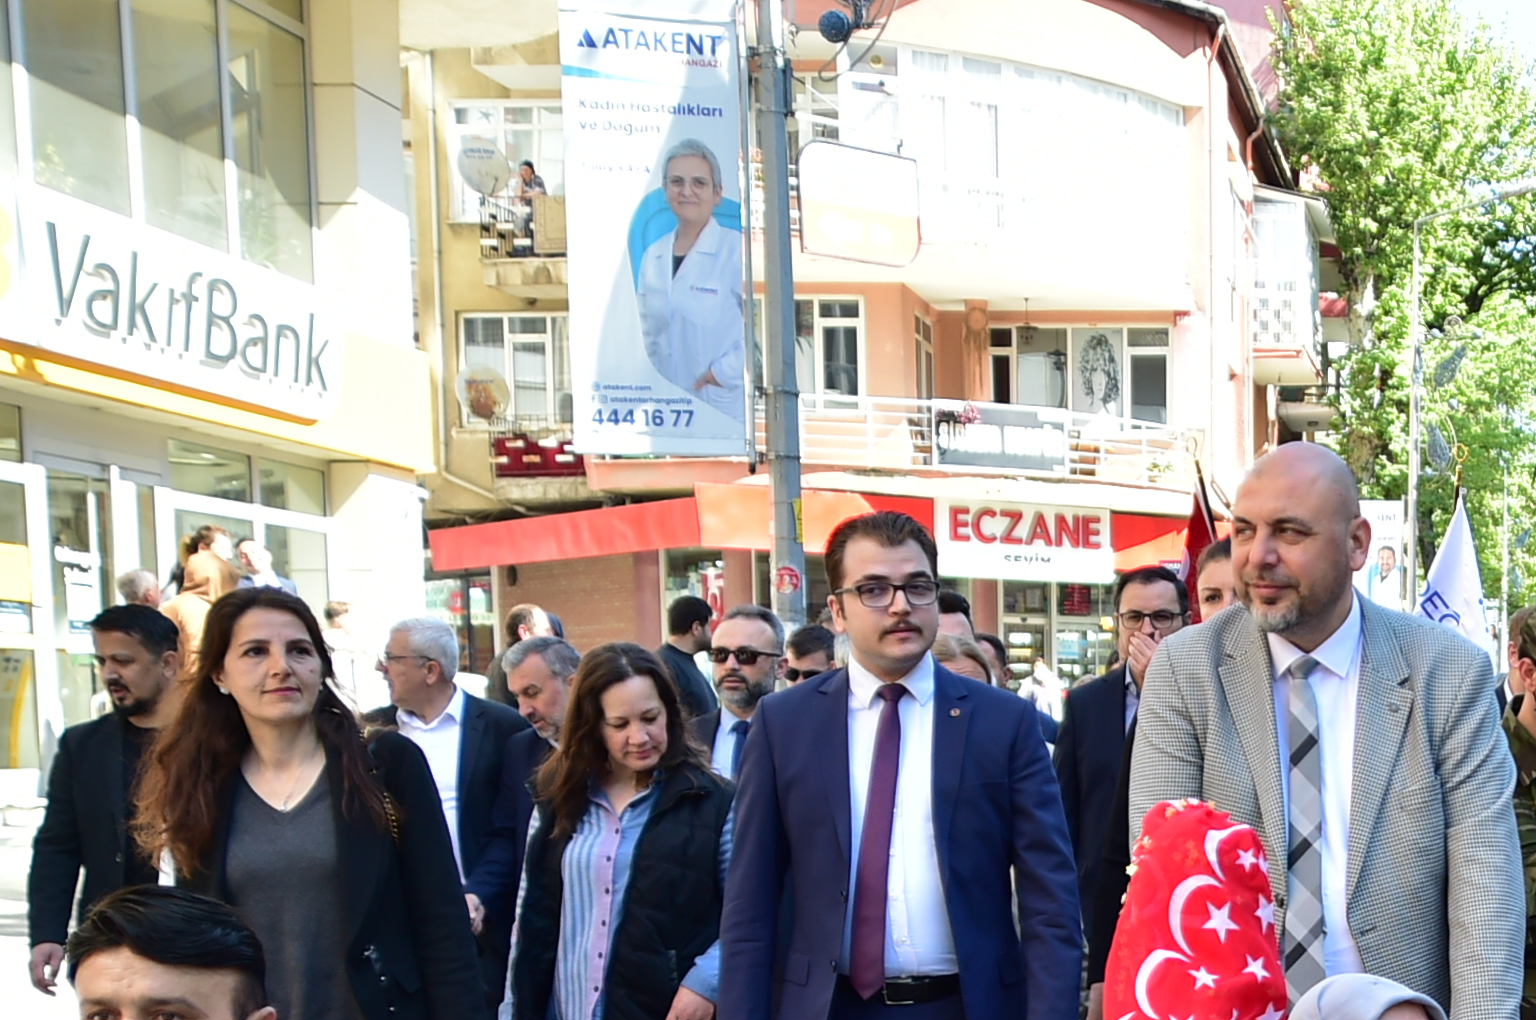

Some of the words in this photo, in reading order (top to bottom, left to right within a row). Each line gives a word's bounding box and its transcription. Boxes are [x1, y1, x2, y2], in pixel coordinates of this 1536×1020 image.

[602, 27, 722, 57] ATAKENT
[630, 101, 723, 118] Hastalıkları
[46, 220, 328, 392] VakıfBank
[591, 408, 636, 426] 444
[641, 408, 665, 427] 16
[669, 409, 695, 428] 77
[949, 505, 1102, 550] ECZANE
